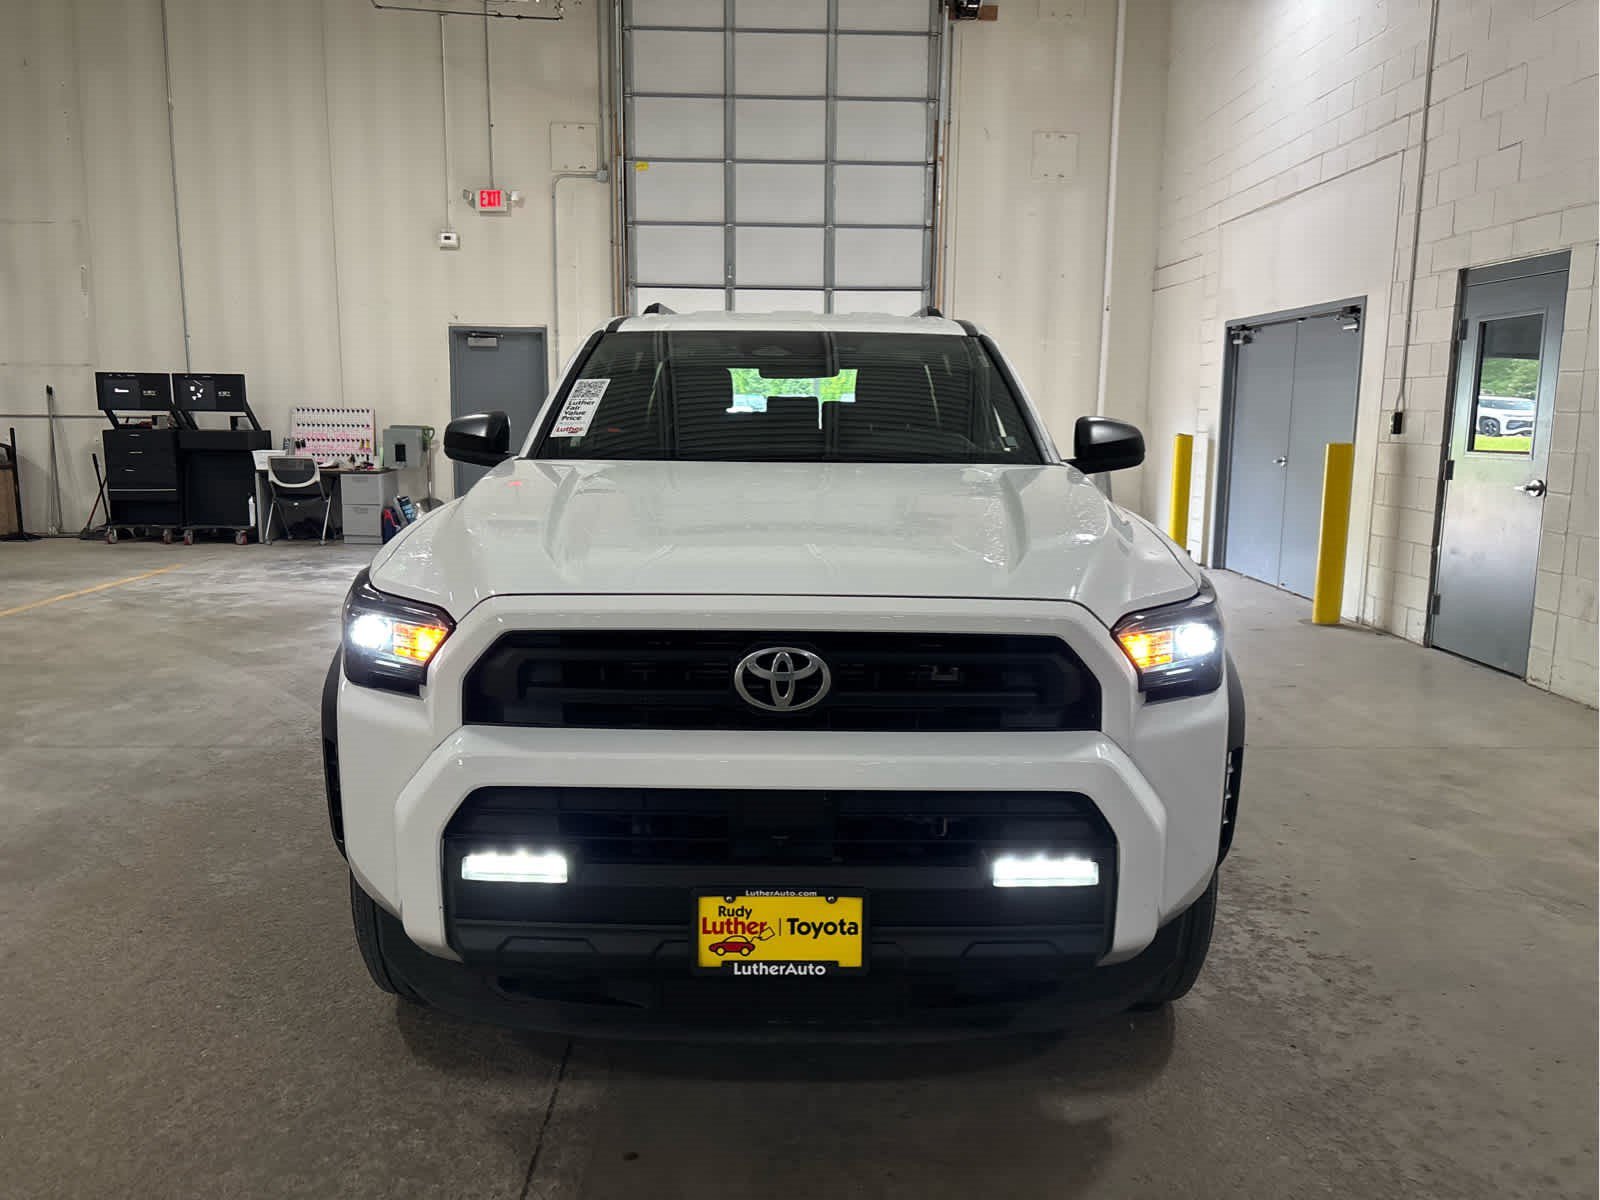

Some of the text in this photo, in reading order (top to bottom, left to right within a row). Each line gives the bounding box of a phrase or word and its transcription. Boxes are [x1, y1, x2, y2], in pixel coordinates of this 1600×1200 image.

[480, 190, 501, 208] EXIT
[745, 889, 817, 897] LutherAuto.com
[718, 905, 752, 919] Rudy
[702, 917, 859, 939] Luther Toyota
[733, 963, 826, 976] LutherAuto
